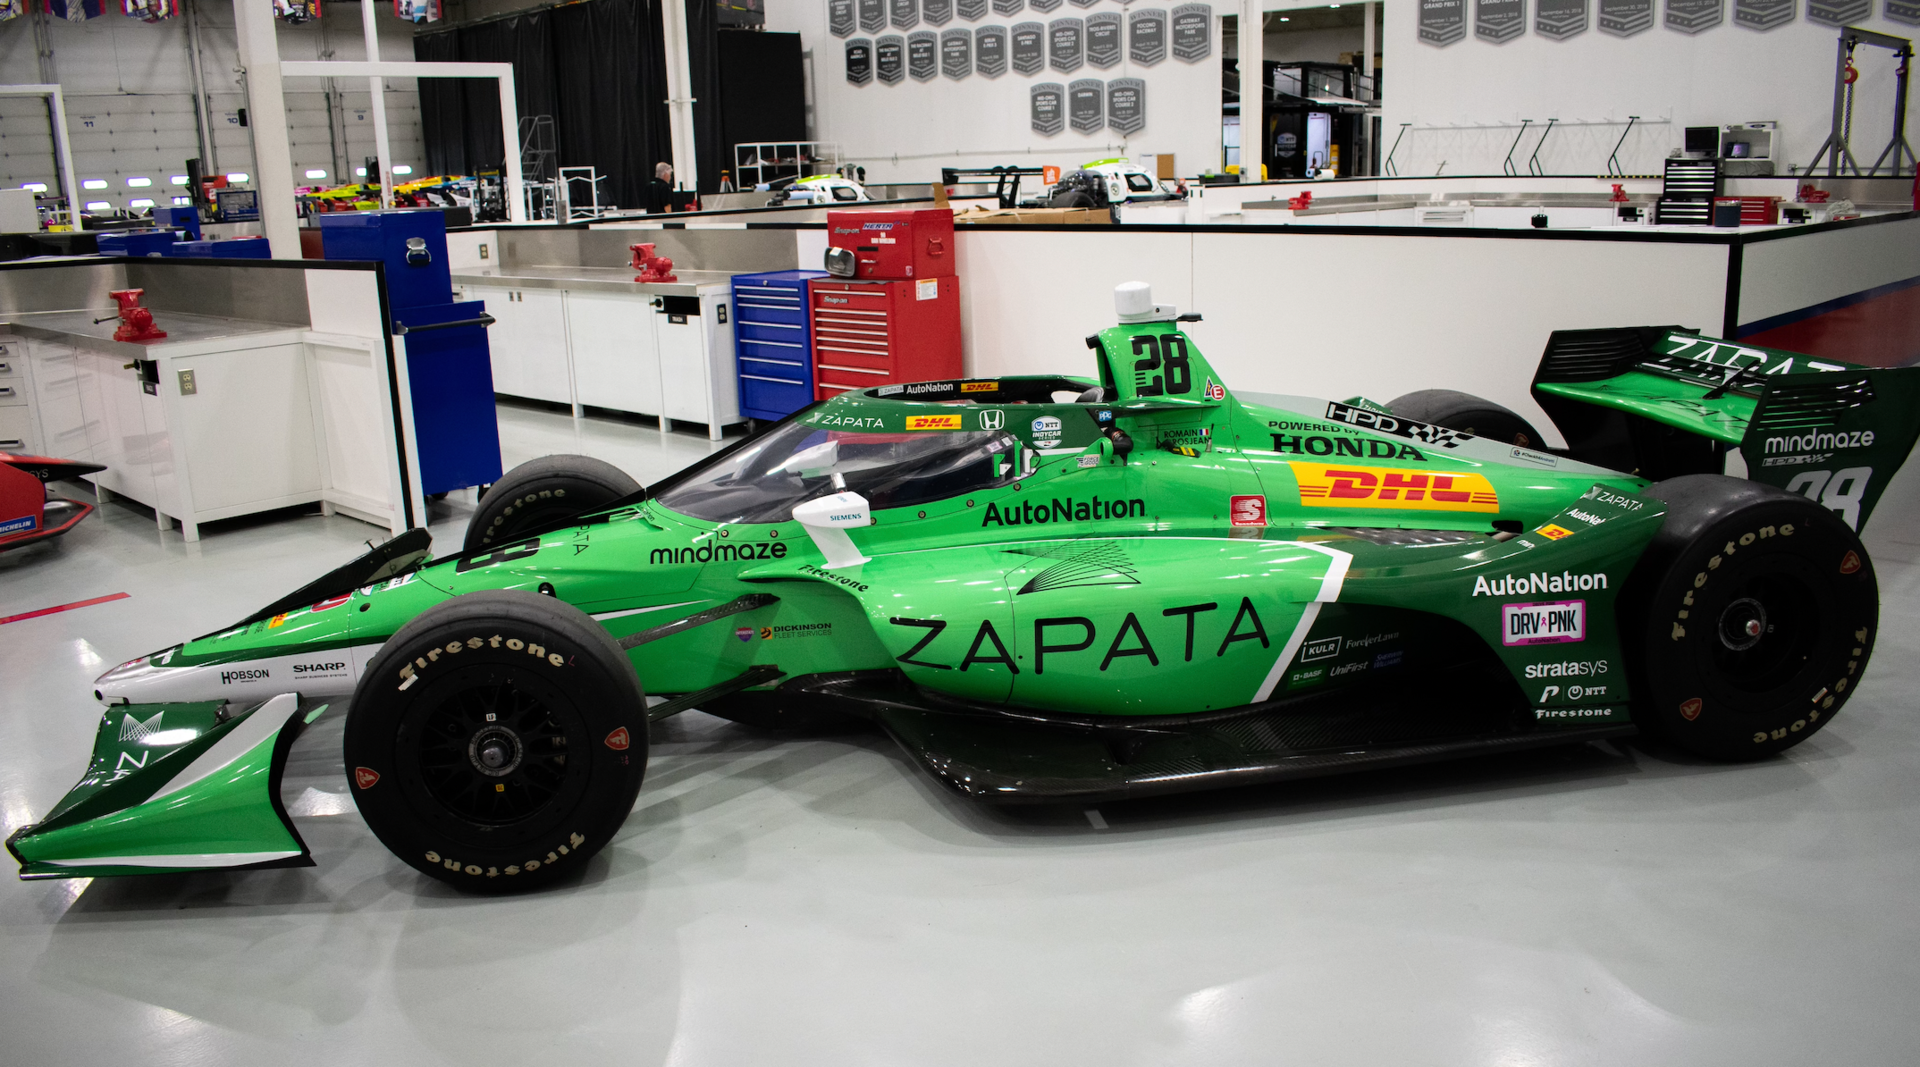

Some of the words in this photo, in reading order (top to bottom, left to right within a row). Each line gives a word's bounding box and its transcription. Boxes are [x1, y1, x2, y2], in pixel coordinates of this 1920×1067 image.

[1173, 6, 1208, 16] WINNER
[1423, 2, 1443, 10] GRAND
[1087, 15, 1118, 24] WINNER
[1130, 12, 1163, 21] WINNER
[1012, 25, 1041, 33] WINNER
[1050, 20, 1080, 29] WINNER
[908, 33, 934, 41] WINNER
[942, 31, 968, 39] WINNER
[976, 28, 1003, 36] WINNER
[846, 39, 870, 47] WINNER
[876, 36, 901, 46] WINNER
[1032, 84, 1061, 93] WINNER
[1070, 81, 1101, 90] WINNER
[1108, 80, 1141, 89] WINNER
[834, 227, 860, 236] Snap-on
[862, 222, 893, 230] HERTA
[824, 296, 848, 305] Snap-on
[1131, 333, 1192, 398] 28
[884, 386, 903, 394] ZAPATA
[906, 383, 954, 395] AutoNation
[966, 383, 993, 391] DHL
[822, 415, 884, 429] ZAPATA
[914, 417, 954, 428] DHL
[1326, 403, 1399, 432] HPD
[1268, 421, 1341, 433] POWERED
[1032, 430, 1062, 438] INDYCAR
[1164, 429, 1198, 439] ROMAIN
[1172, 437, 1210, 446] ROSJEAN
[1764, 428, 1875, 454] mindmaze
[1270, 433, 1427, 462] HONDA
[1325, 470, 1472, 503] DHL
[1597, 491, 1644, 511] ZAPATA
[483, 488, 566, 544] irestone
[981, 495, 1146, 527] AutoNation
[829, 513, 862, 522] SIEMENS
[649, 539, 788, 565] mindmaze
[797, 564, 870, 593] Firestone
[1471, 570, 1608, 597] AutoNation
[1671, 523, 1796, 642] Firestone
[774, 623, 832, 633] DICKINSON
[1510, 611, 1541, 636] DRV
[1548, 609, 1577, 634] PNK
[774, 631, 795, 639] FLEET
[797, 629, 832, 638] SERVICES
[888, 595, 1271, 675] ZAPATA
[1308, 643, 1336, 656] KULR
[399, 634, 565, 682] Firestone
[293, 662, 345, 673] SHARP
[1329, 661, 1368, 677] UniFirst
[1525, 659, 1608, 679] stratasys
[221, 669, 270, 685] HOBSON
[1303, 669, 1323, 679] BASF
[1753, 626, 1869, 744] Firestone
[1584, 686, 1607, 697] NTT
[1535, 707, 1612, 719] Firestone
[424, 831, 586, 879] Firestone
